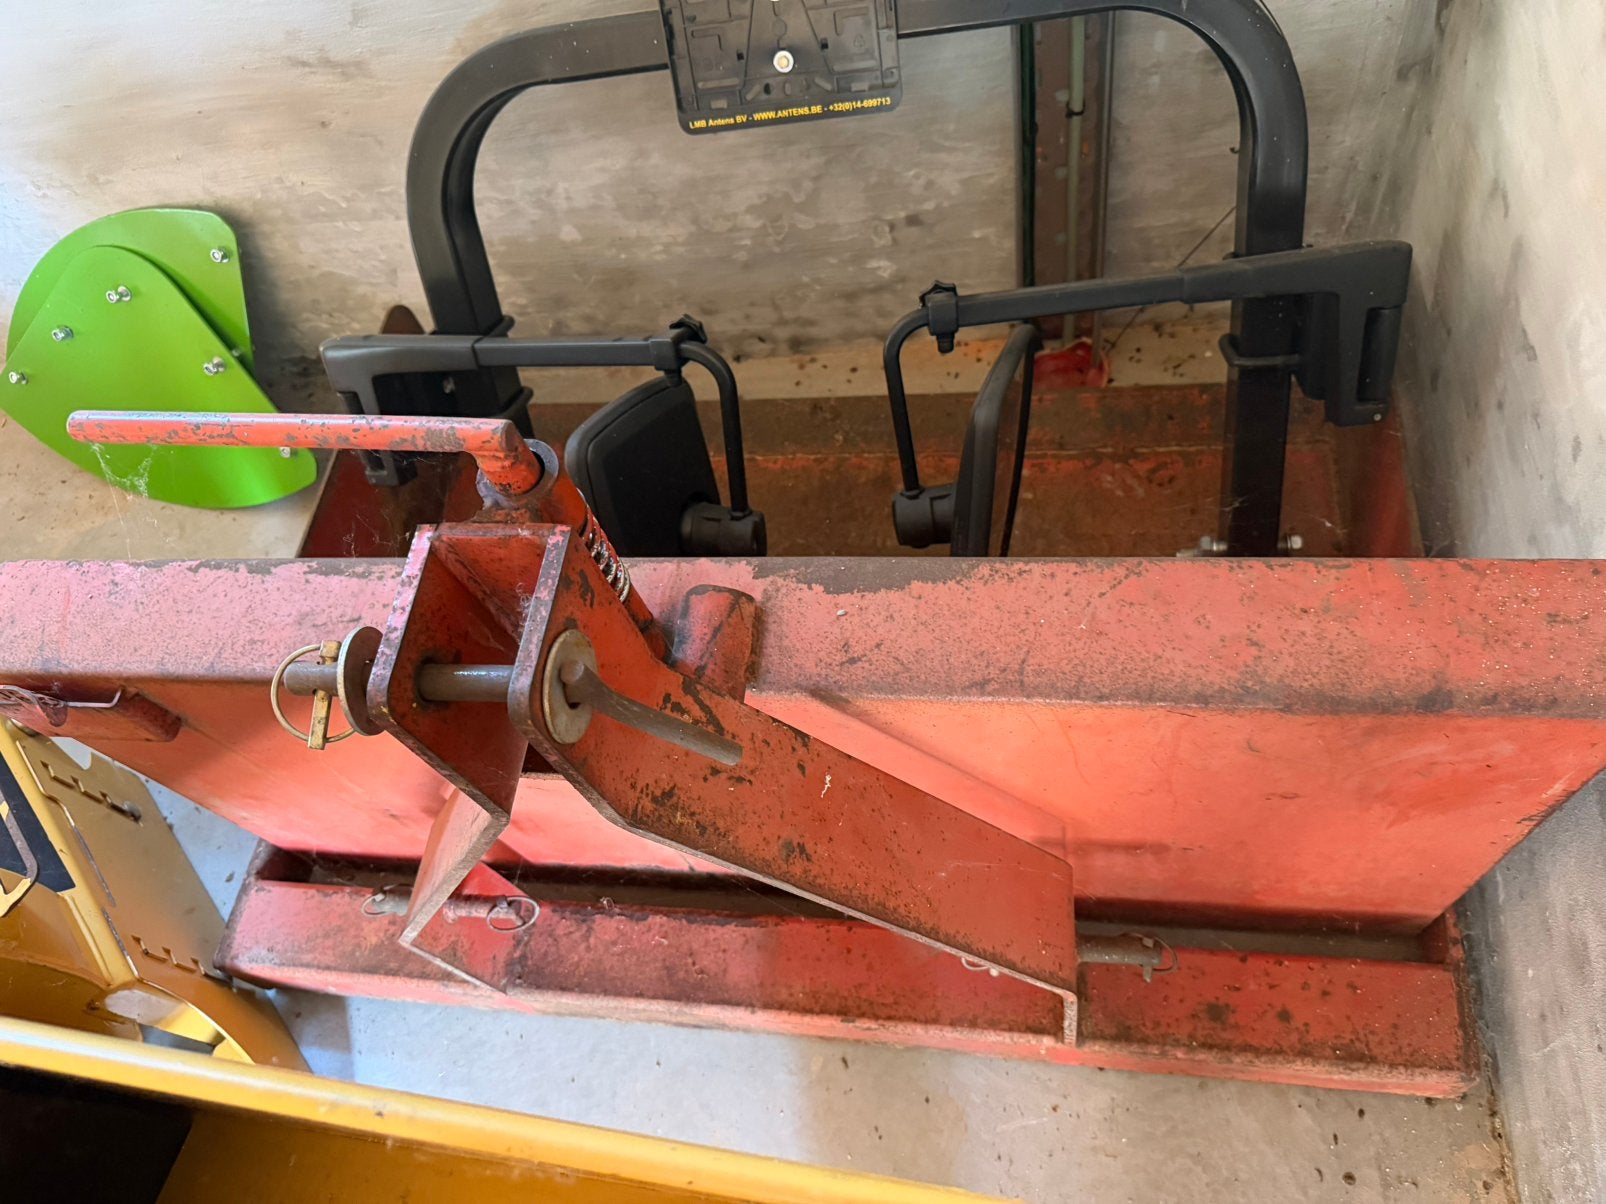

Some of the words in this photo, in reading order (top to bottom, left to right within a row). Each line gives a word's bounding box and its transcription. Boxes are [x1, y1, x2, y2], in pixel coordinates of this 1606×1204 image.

[690, 120, 707, 130] LMB
[708, 117, 735, 128] Antens
[736, 114, 748, 124] BV
[753, 105, 823, 121] WWW.ANTENS.BE
